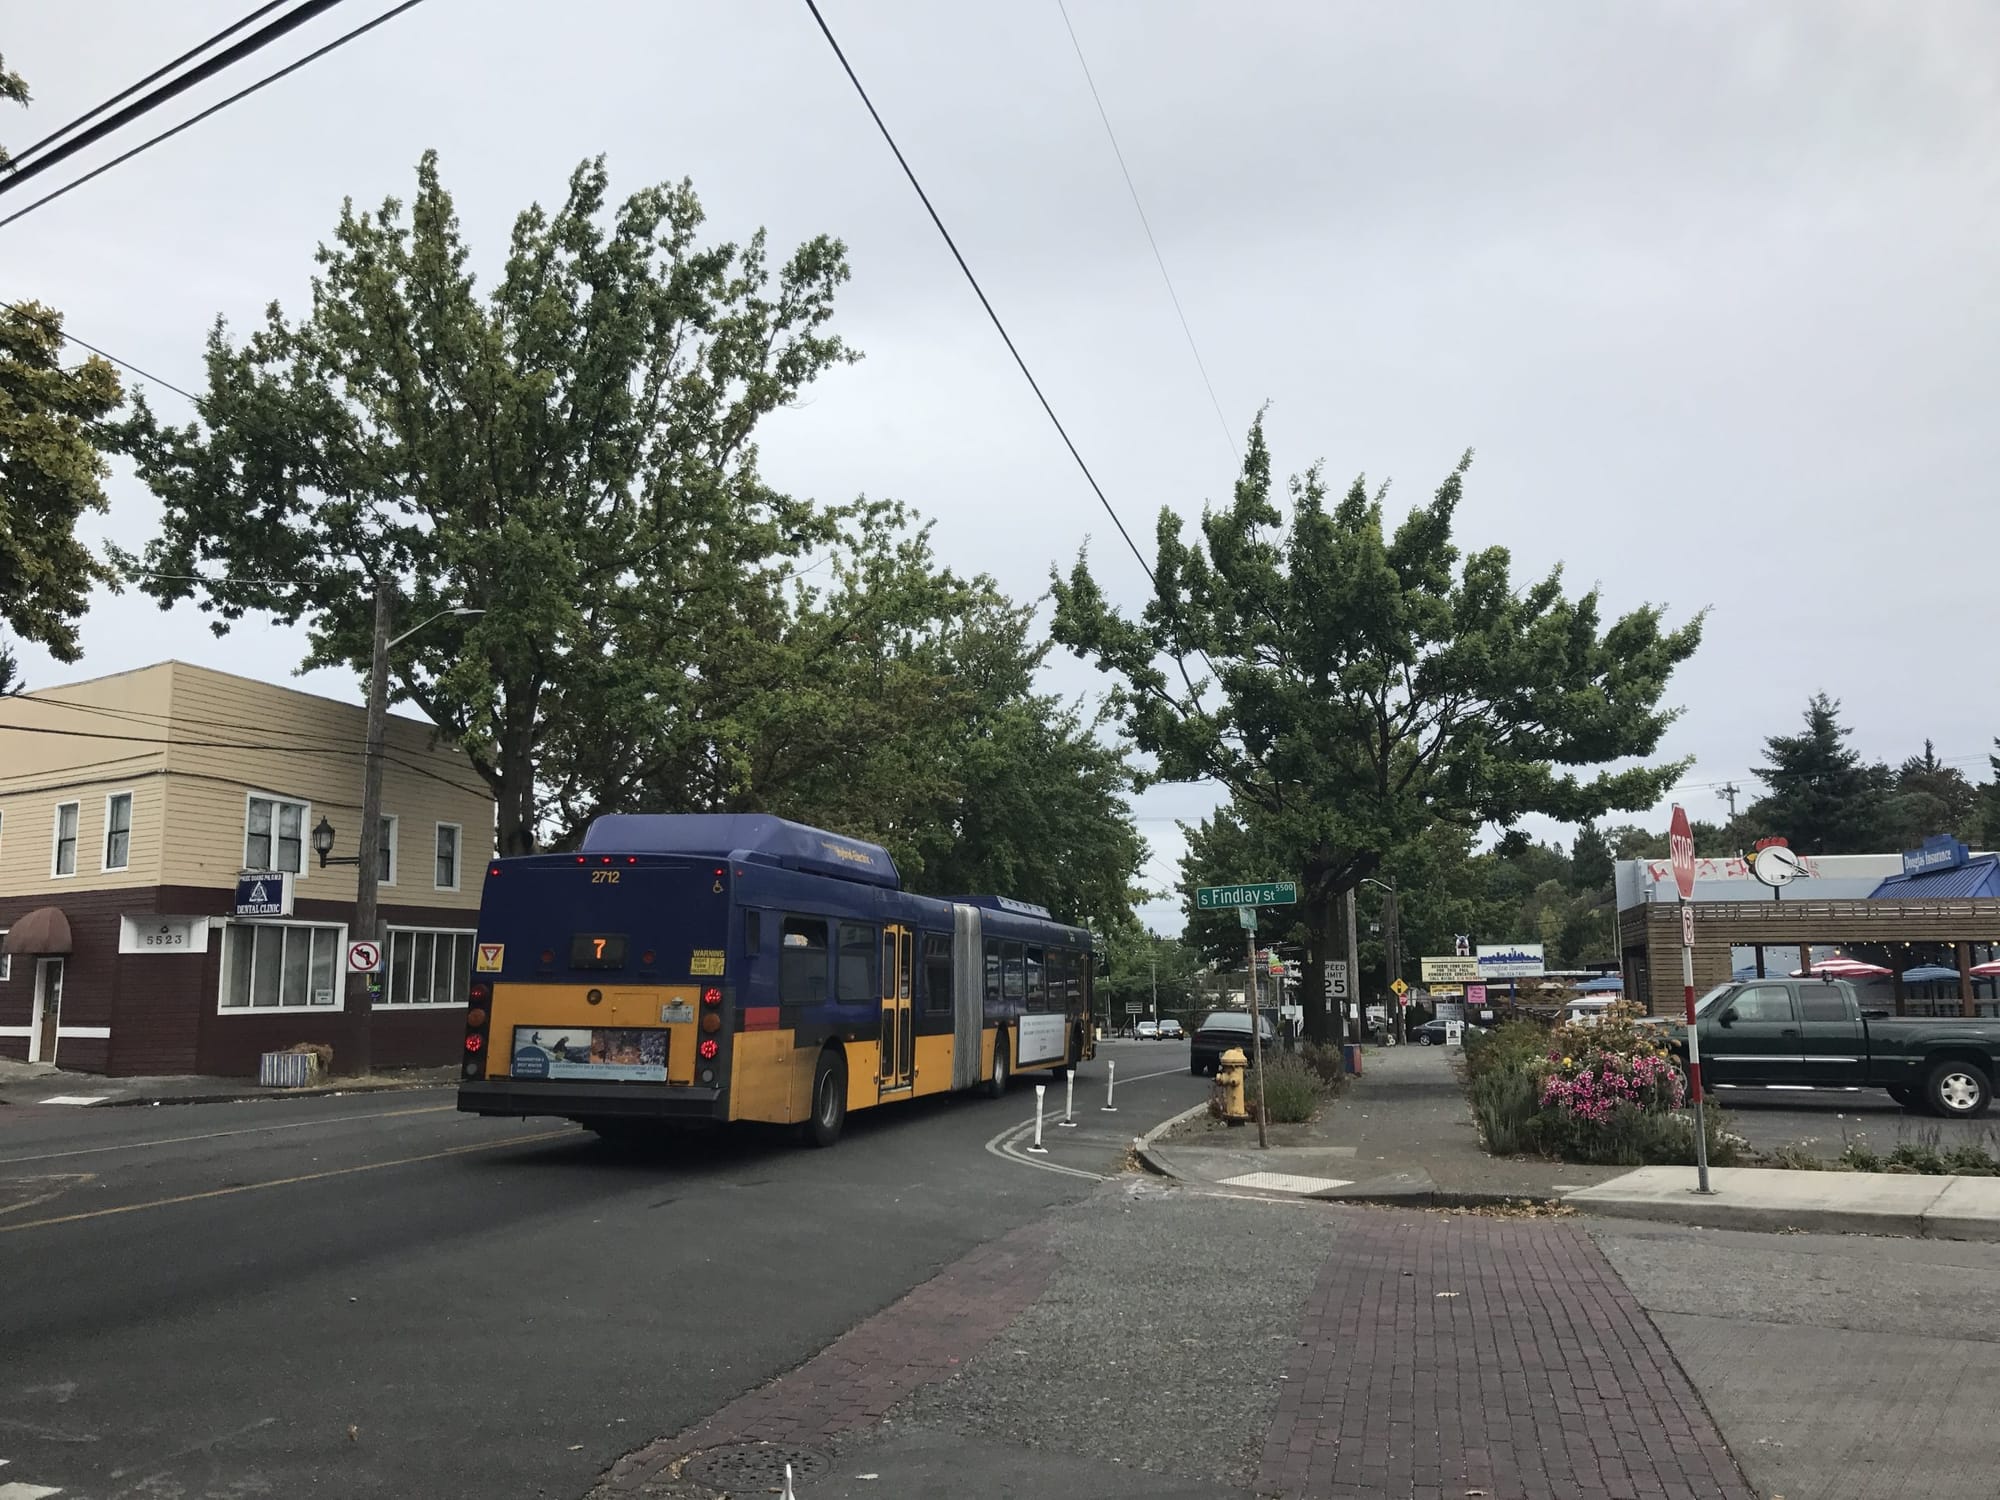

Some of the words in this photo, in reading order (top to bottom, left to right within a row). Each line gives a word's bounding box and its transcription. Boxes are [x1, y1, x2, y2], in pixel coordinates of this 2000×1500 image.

[1672, 834, 1692, 870] STOP
[1904, 851, 1925, 872] Douglas
[1925, 849, 1952, 865] Insurance
[591, 871, 620, 883] 2712
[1201, 894, 1209, 905] S
[1212, 888, 1260, 904] Findlay
[1263, 890, 1276, 901] St
[1275, 884, 1294, 892] 5500
[237, 904, 260, 914] DENTAL
[260, 903, 281, 913] CLINIC
[146, 934, 183, 945] 5523
[593, 939, 606, 960] 7
[693, 949, 725, 958] WARNING
[1324, 980, 1345, 993] 25
